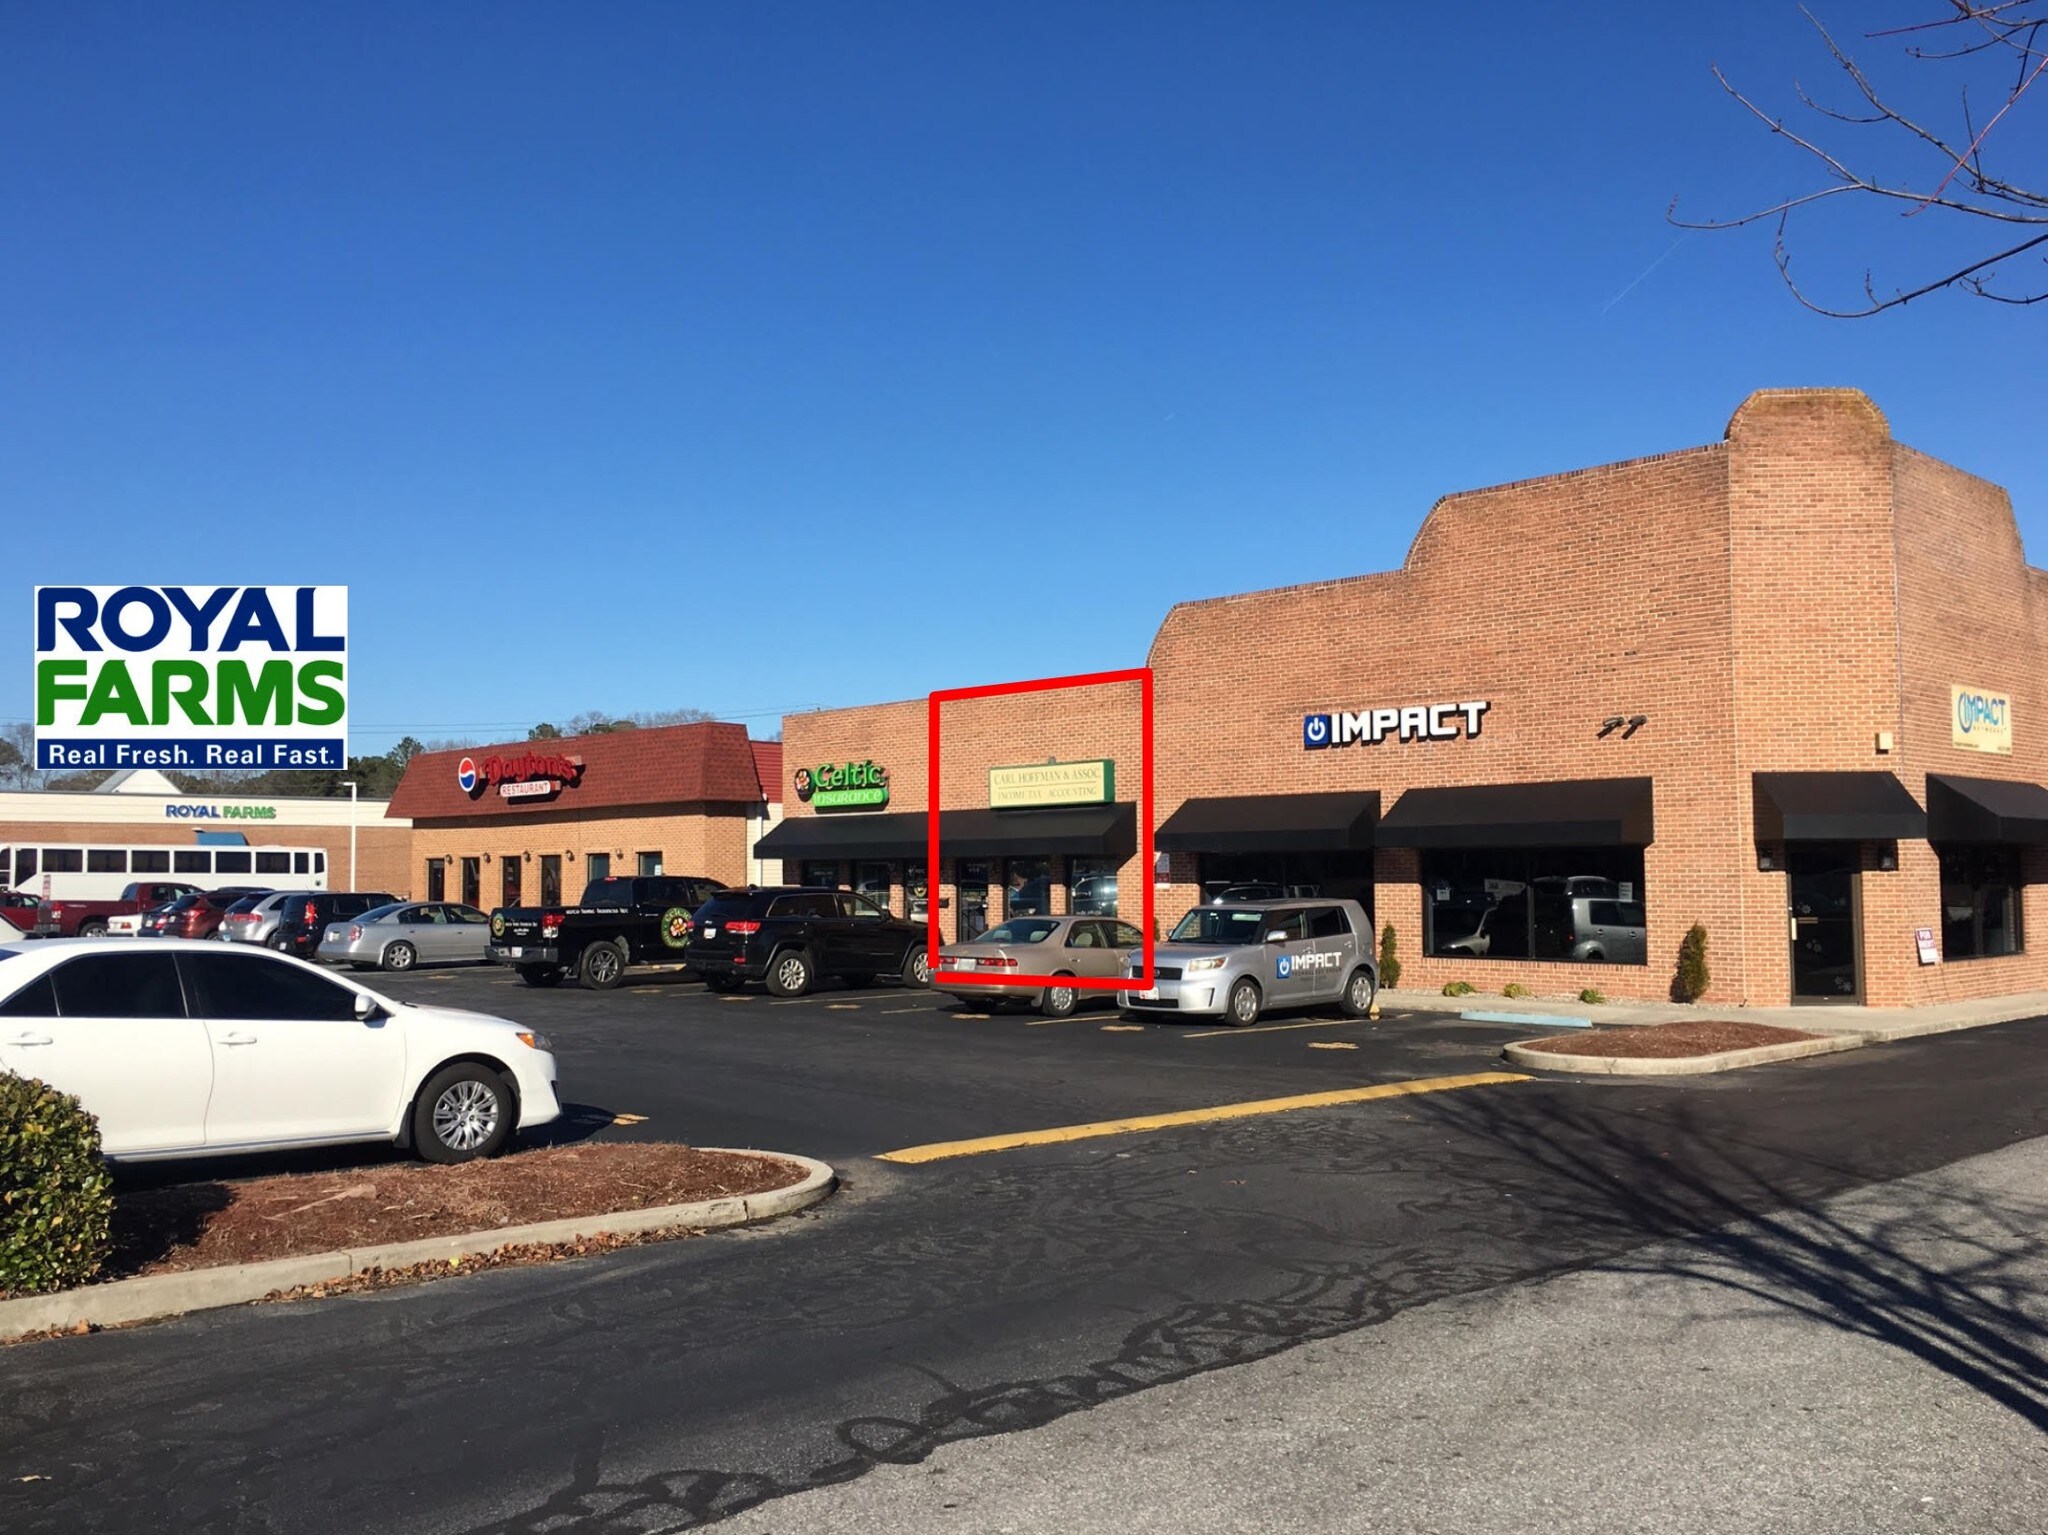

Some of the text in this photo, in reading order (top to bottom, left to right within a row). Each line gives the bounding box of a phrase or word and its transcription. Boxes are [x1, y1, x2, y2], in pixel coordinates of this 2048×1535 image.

[1331, 701, 1489, 745] IMPACT
[815, 760, 882, 787] Celtic
[994, 774, 1016, 785] CARL
[1018, 768, 1060, 783] HOFFMAN
[1063, 768, 1070, 780] &
[502, 782, 549, 796] RESTAURANT
[1048, 785, 1097, 798] ACCOUNTING
[166, 804, 277, 820] ROYAL FARMS
[1291, 951, 1342, 970] IMPACT
